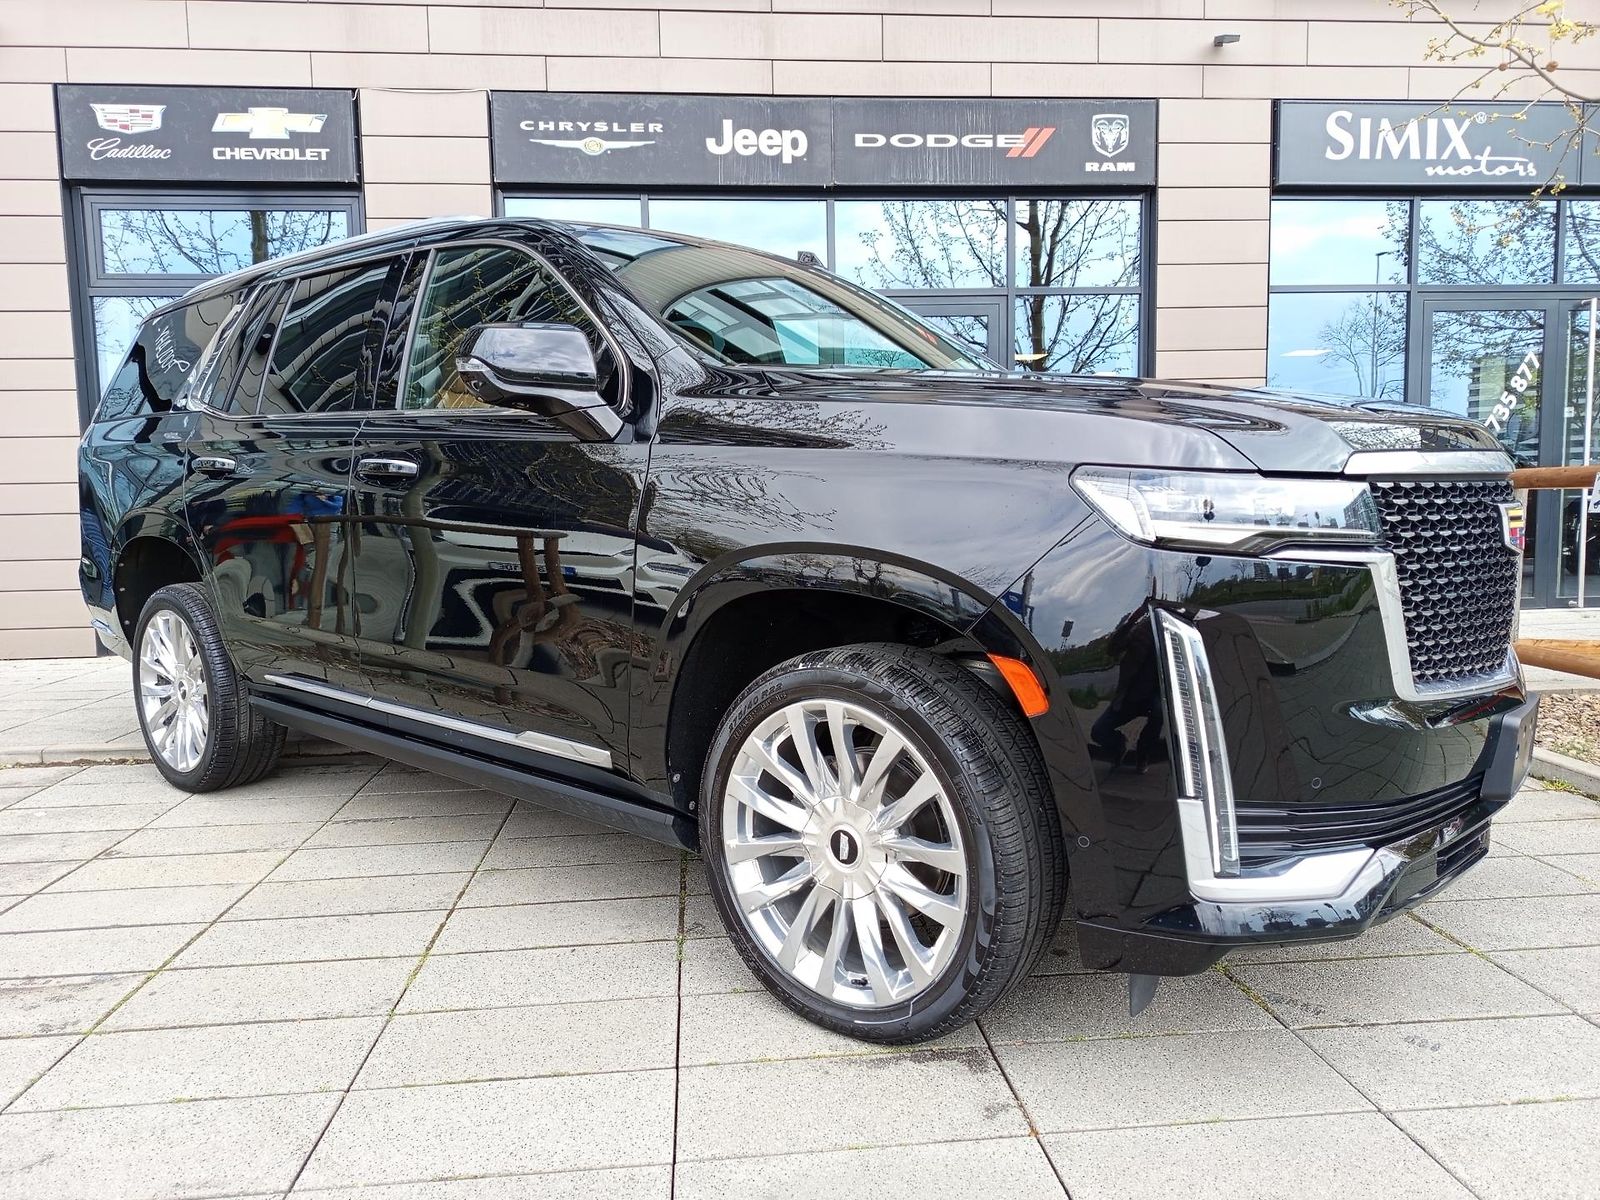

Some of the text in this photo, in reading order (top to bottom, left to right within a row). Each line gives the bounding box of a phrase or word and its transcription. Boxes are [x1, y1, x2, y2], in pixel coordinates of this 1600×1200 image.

[519, 120, 664, 134] CHRYSLER
[1325, 110, 1472, 160] SIMIX
[87, 137, 172, 161] Cadillac
[705, 118, 808, 164] Jeep
[853, 133, 1027, 149] DODGE
[212, 147, 330, 162] CHEVROLET
[1425, 146, 1538, 177] motors
[1085, 162, 1136, 172] RAM
[1510, 350, 1541, 393] 877
